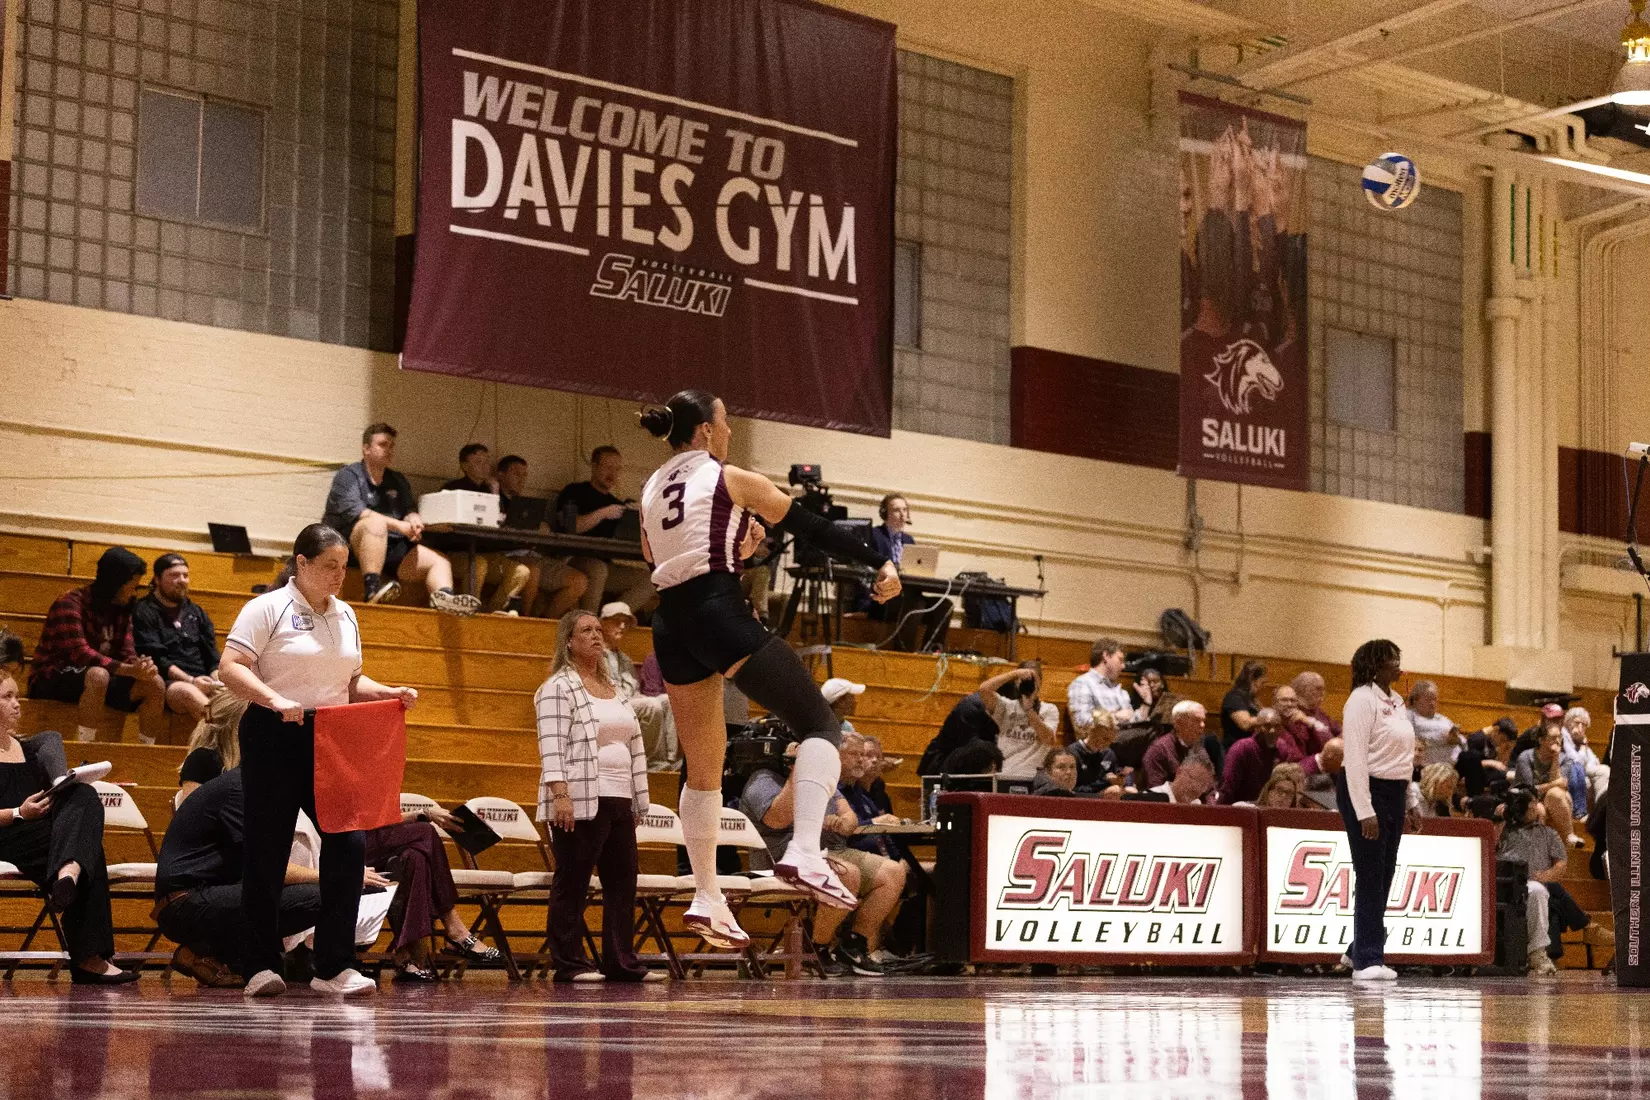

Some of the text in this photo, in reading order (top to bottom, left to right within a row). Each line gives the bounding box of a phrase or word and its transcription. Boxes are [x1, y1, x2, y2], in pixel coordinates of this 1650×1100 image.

[464, 71, 785, 180] WELCOME TO
[452, 118, 857, 285] DAVIES GYM
[590, 253, 732, 317] SALUKI
[1202, 418, 1285, 457] SALUKI
[661, 481, 687, 531] 3
[477, 808, 518, 822] SALUKI
[996, 829, 1223, 914] SALUKI
[1275, 840, 1465, 919] SAUKI
[1628, 744, 1641, 966] SOUTHERN ILLINOIS UNIVERSITY
[995, 919, 1223, 944] VOLLEYBALL
[1274, 923, 1466, 947] VOLLYBALL
